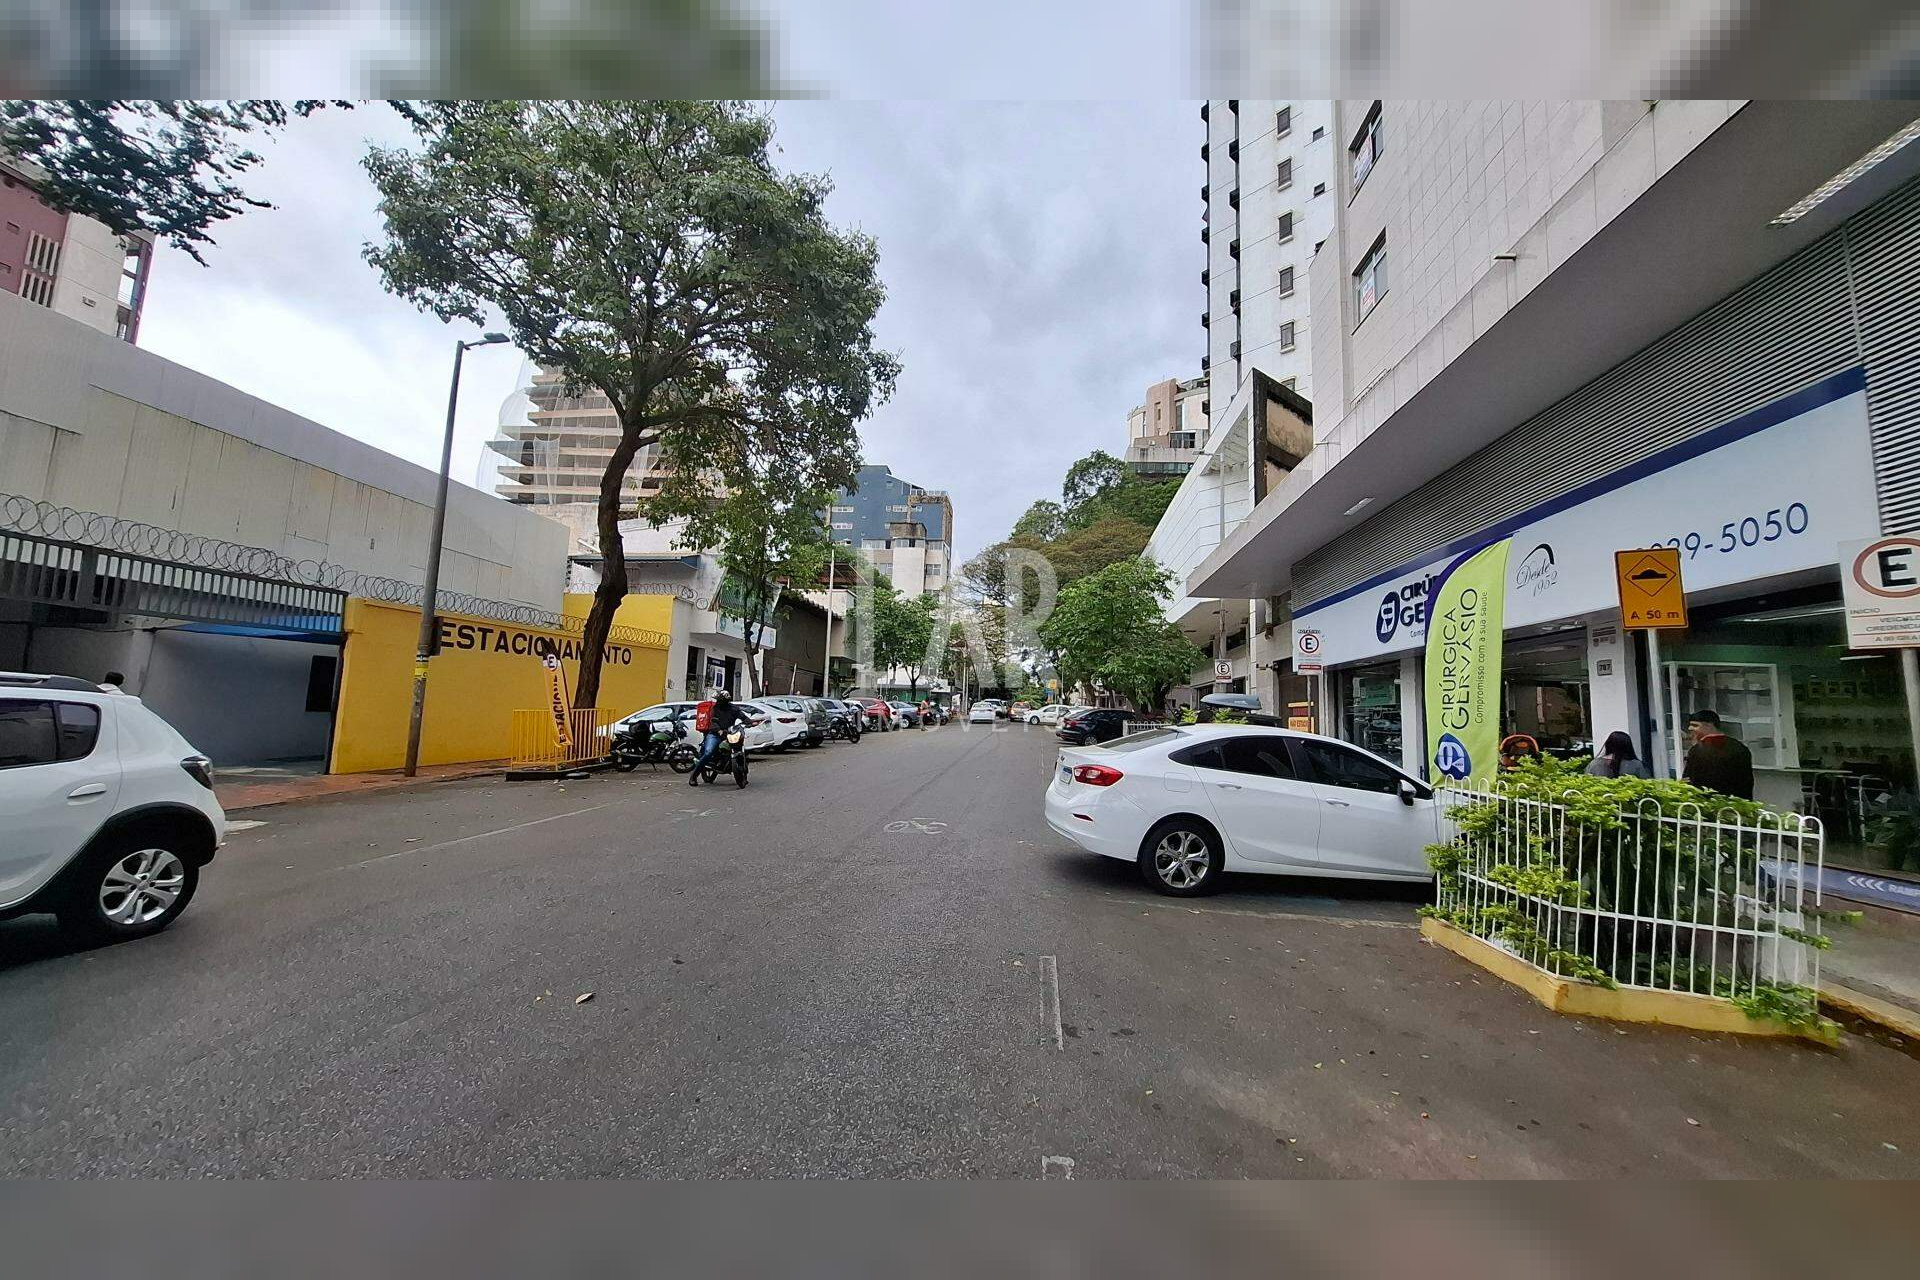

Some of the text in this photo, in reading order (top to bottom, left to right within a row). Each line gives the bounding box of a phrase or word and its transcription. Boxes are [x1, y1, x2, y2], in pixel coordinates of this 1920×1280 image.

[1636, 502, 1809, 560] 9-5050
[1877, 547, 1918, 587] E
[1400, 573, 1440, 602] CIRÚ
[1400, 601, 1426, 626] GE
[1631, 609, 1680, 620] A 50 m
[1479, 619, 1487, 634] sua
[1305, 637, 1314, 650] E
[1478, 645, 1486, 663] com
[548, 656, 555, 668] E
[1220, 664, 1226, 673] E
[1438, 607, 1457, 728] CIRÚRGICA
[1451, 588, 1478, 730] GERVÁSIO
[1475, 666, 1485, 724] Compromisso
